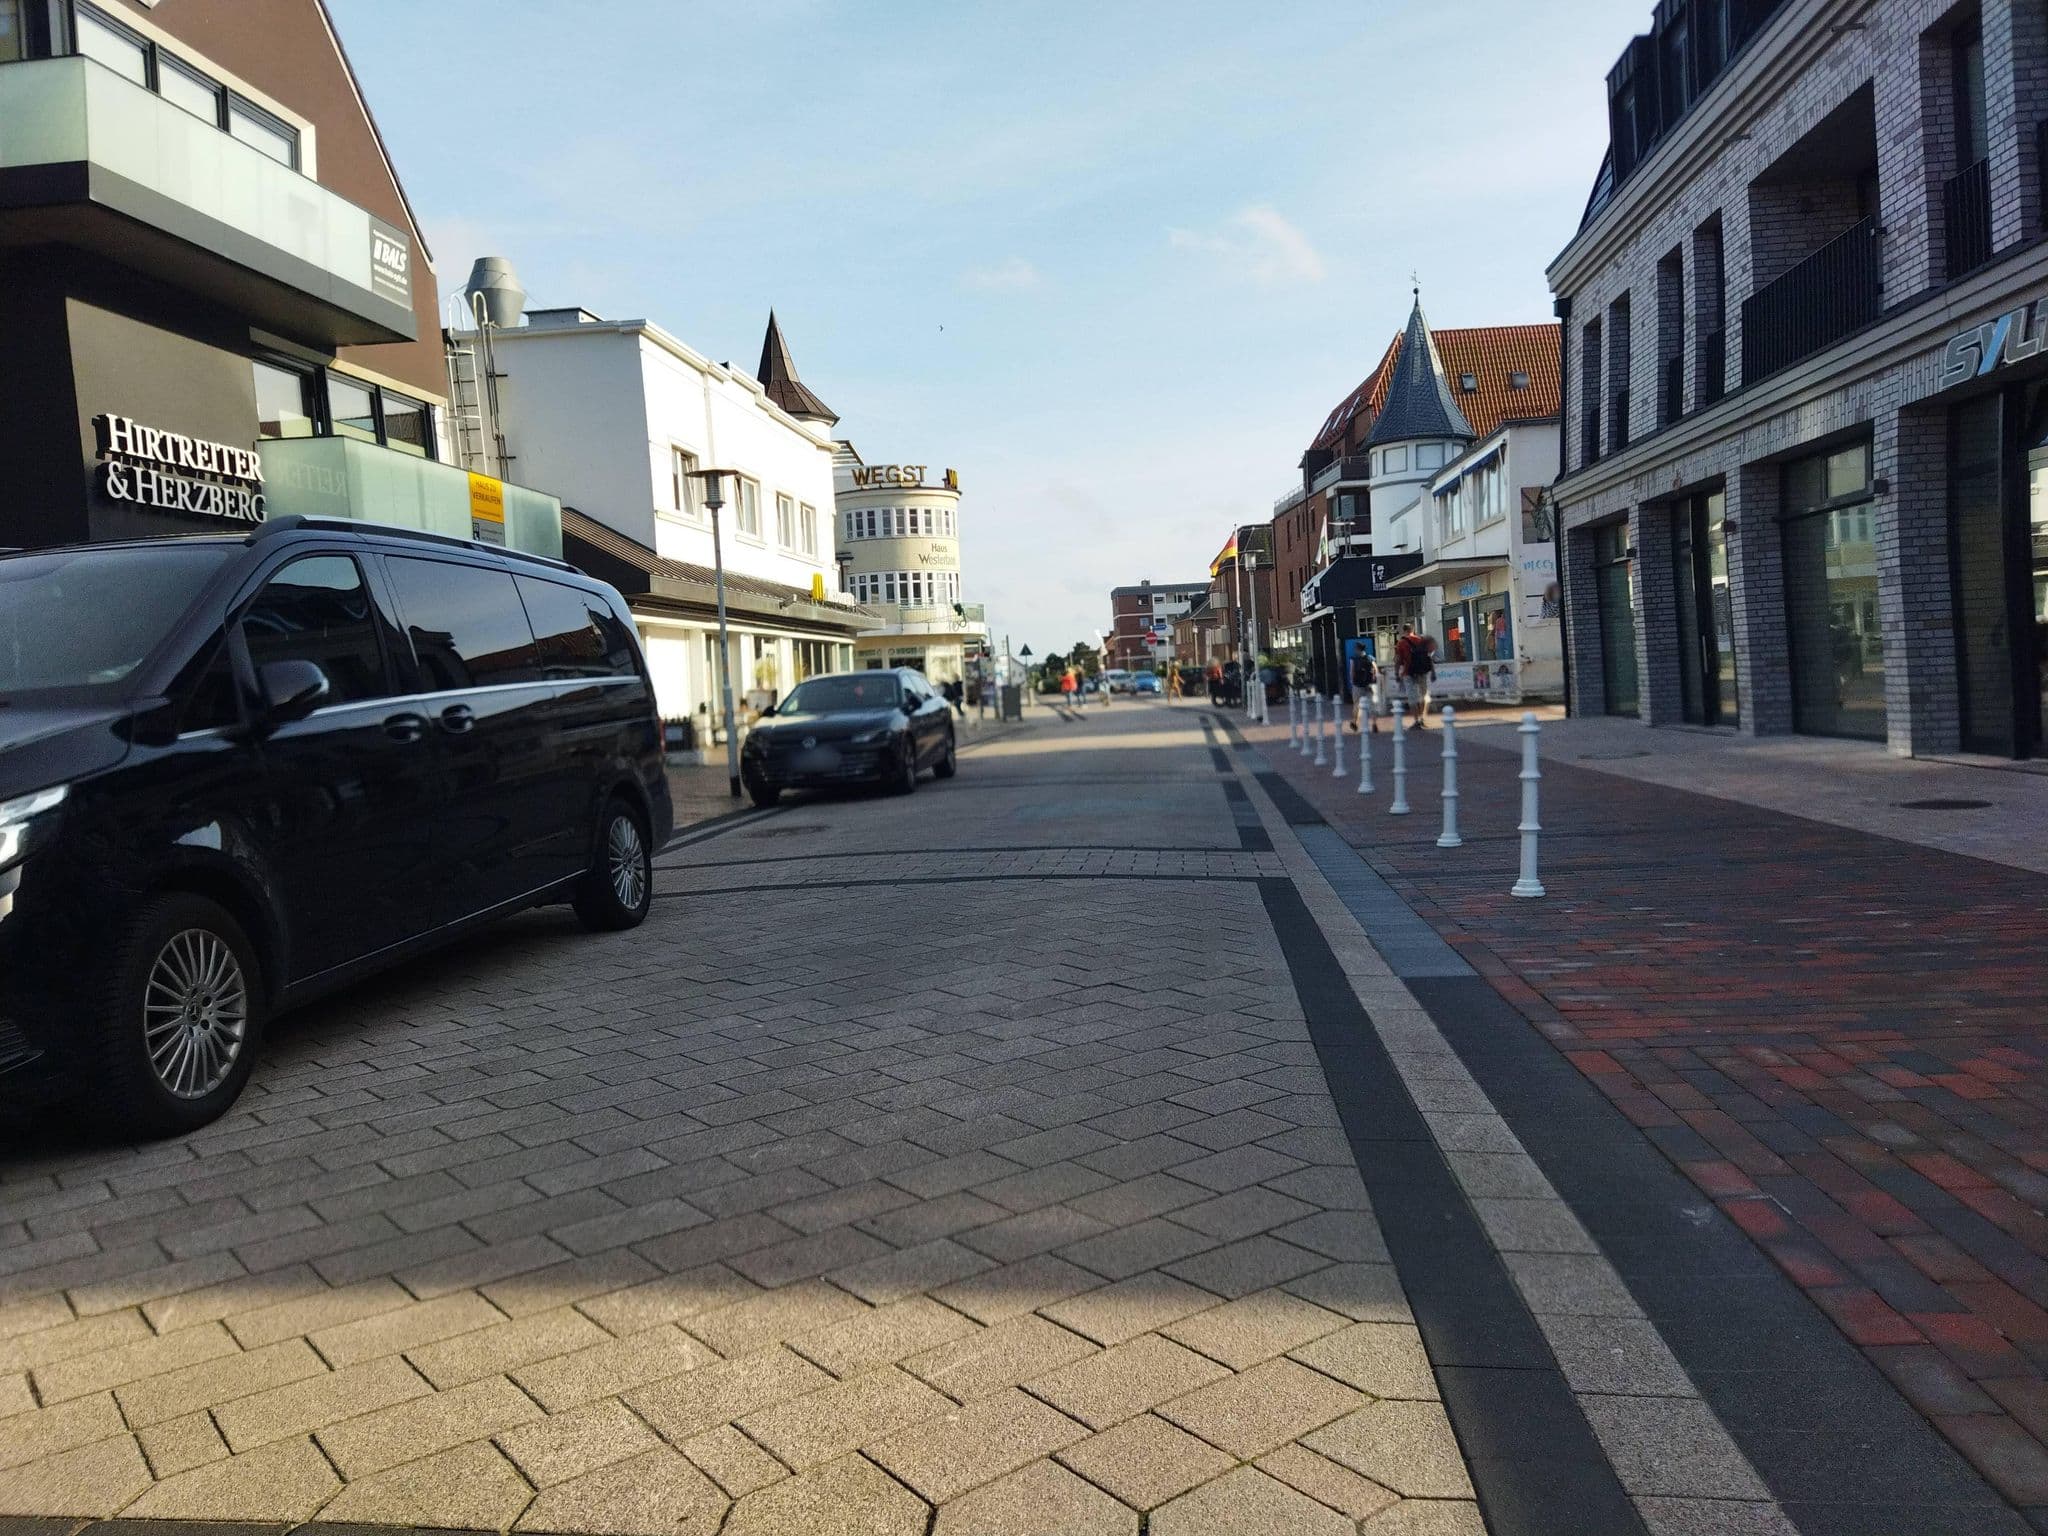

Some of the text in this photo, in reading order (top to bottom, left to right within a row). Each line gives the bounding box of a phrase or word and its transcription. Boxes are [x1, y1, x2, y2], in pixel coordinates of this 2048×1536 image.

[382, 242, 408, 272] BALS
[106, 413, 266, 482] HIRTREITER
[852, 465, 927, 486] WEGST
[106, 461, 268, 523] & HERZBERG
[931, 544, 948, 553] Haus
